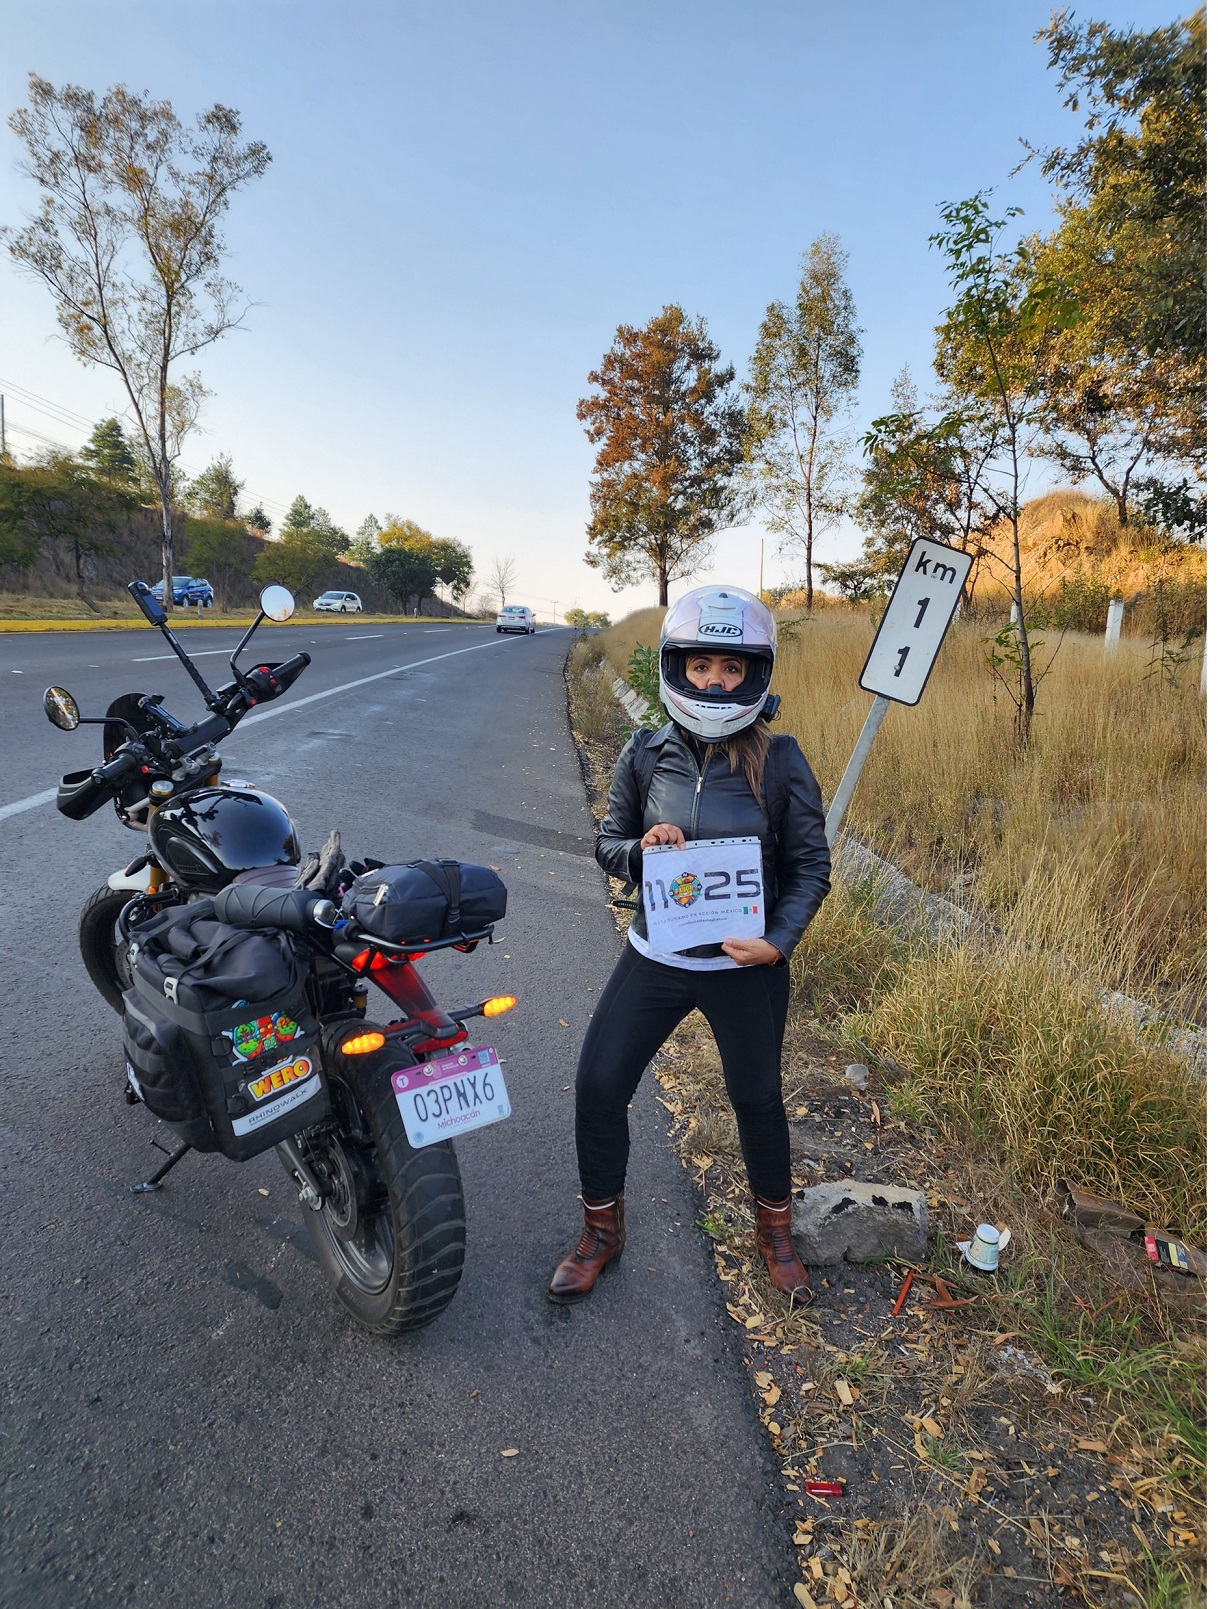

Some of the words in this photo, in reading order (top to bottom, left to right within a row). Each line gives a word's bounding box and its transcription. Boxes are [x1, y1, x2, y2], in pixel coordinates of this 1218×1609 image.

[915, 551, 957, 584] km
[704, 626, 738, 635] HJC
[250, 1059, 310, 1099] WERO
[248, 1087, 308, 1124] RHINOWALK
[413, 1072, 495, 1122] 03PNX6
[437, 1109, 481, 1129] Michoacán
